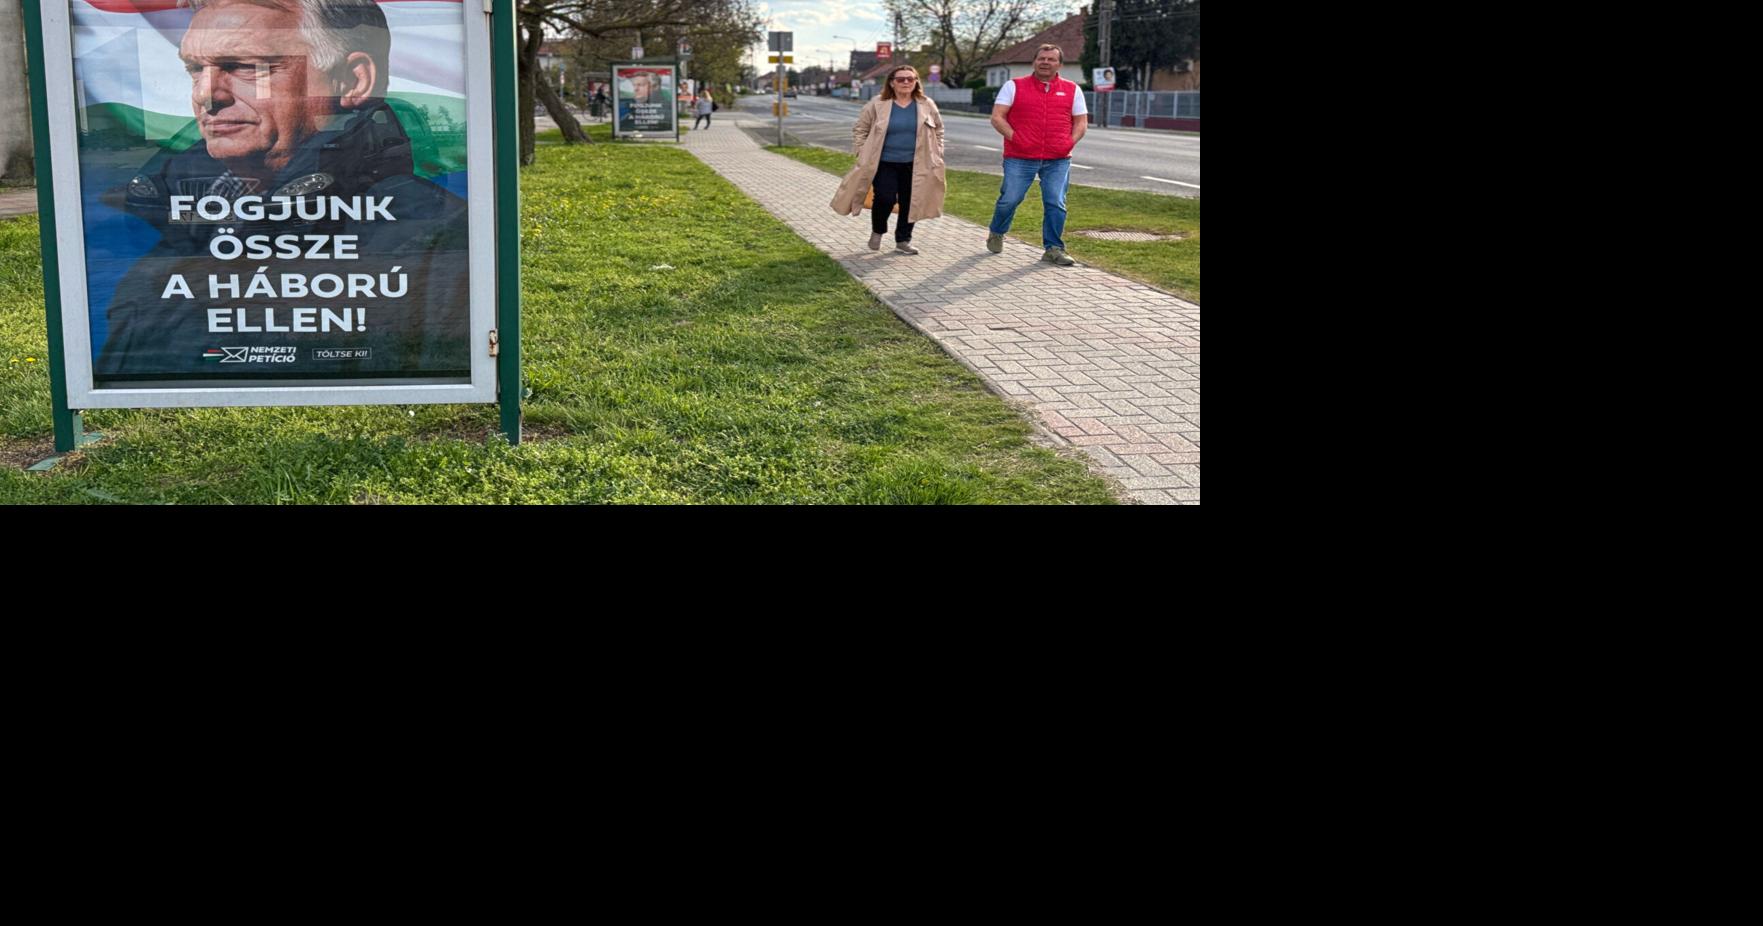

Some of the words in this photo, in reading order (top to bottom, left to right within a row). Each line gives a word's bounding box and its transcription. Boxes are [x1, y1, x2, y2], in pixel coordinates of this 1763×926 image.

[170, 195, 396, 221] FOGJUNK
[209, 228, 359, 260] ÖSSZE
[161, 274, 195, 299] A
[208, 265, 408, 299] HÁBORÚ
[207, 307, 366, 333] ELLEN!
[247, 352, 296, 363] PETÍCIÓ
[250, 346, 297, 354] NEMZETI
[316, 350, 353, 358] TÖLTSE
